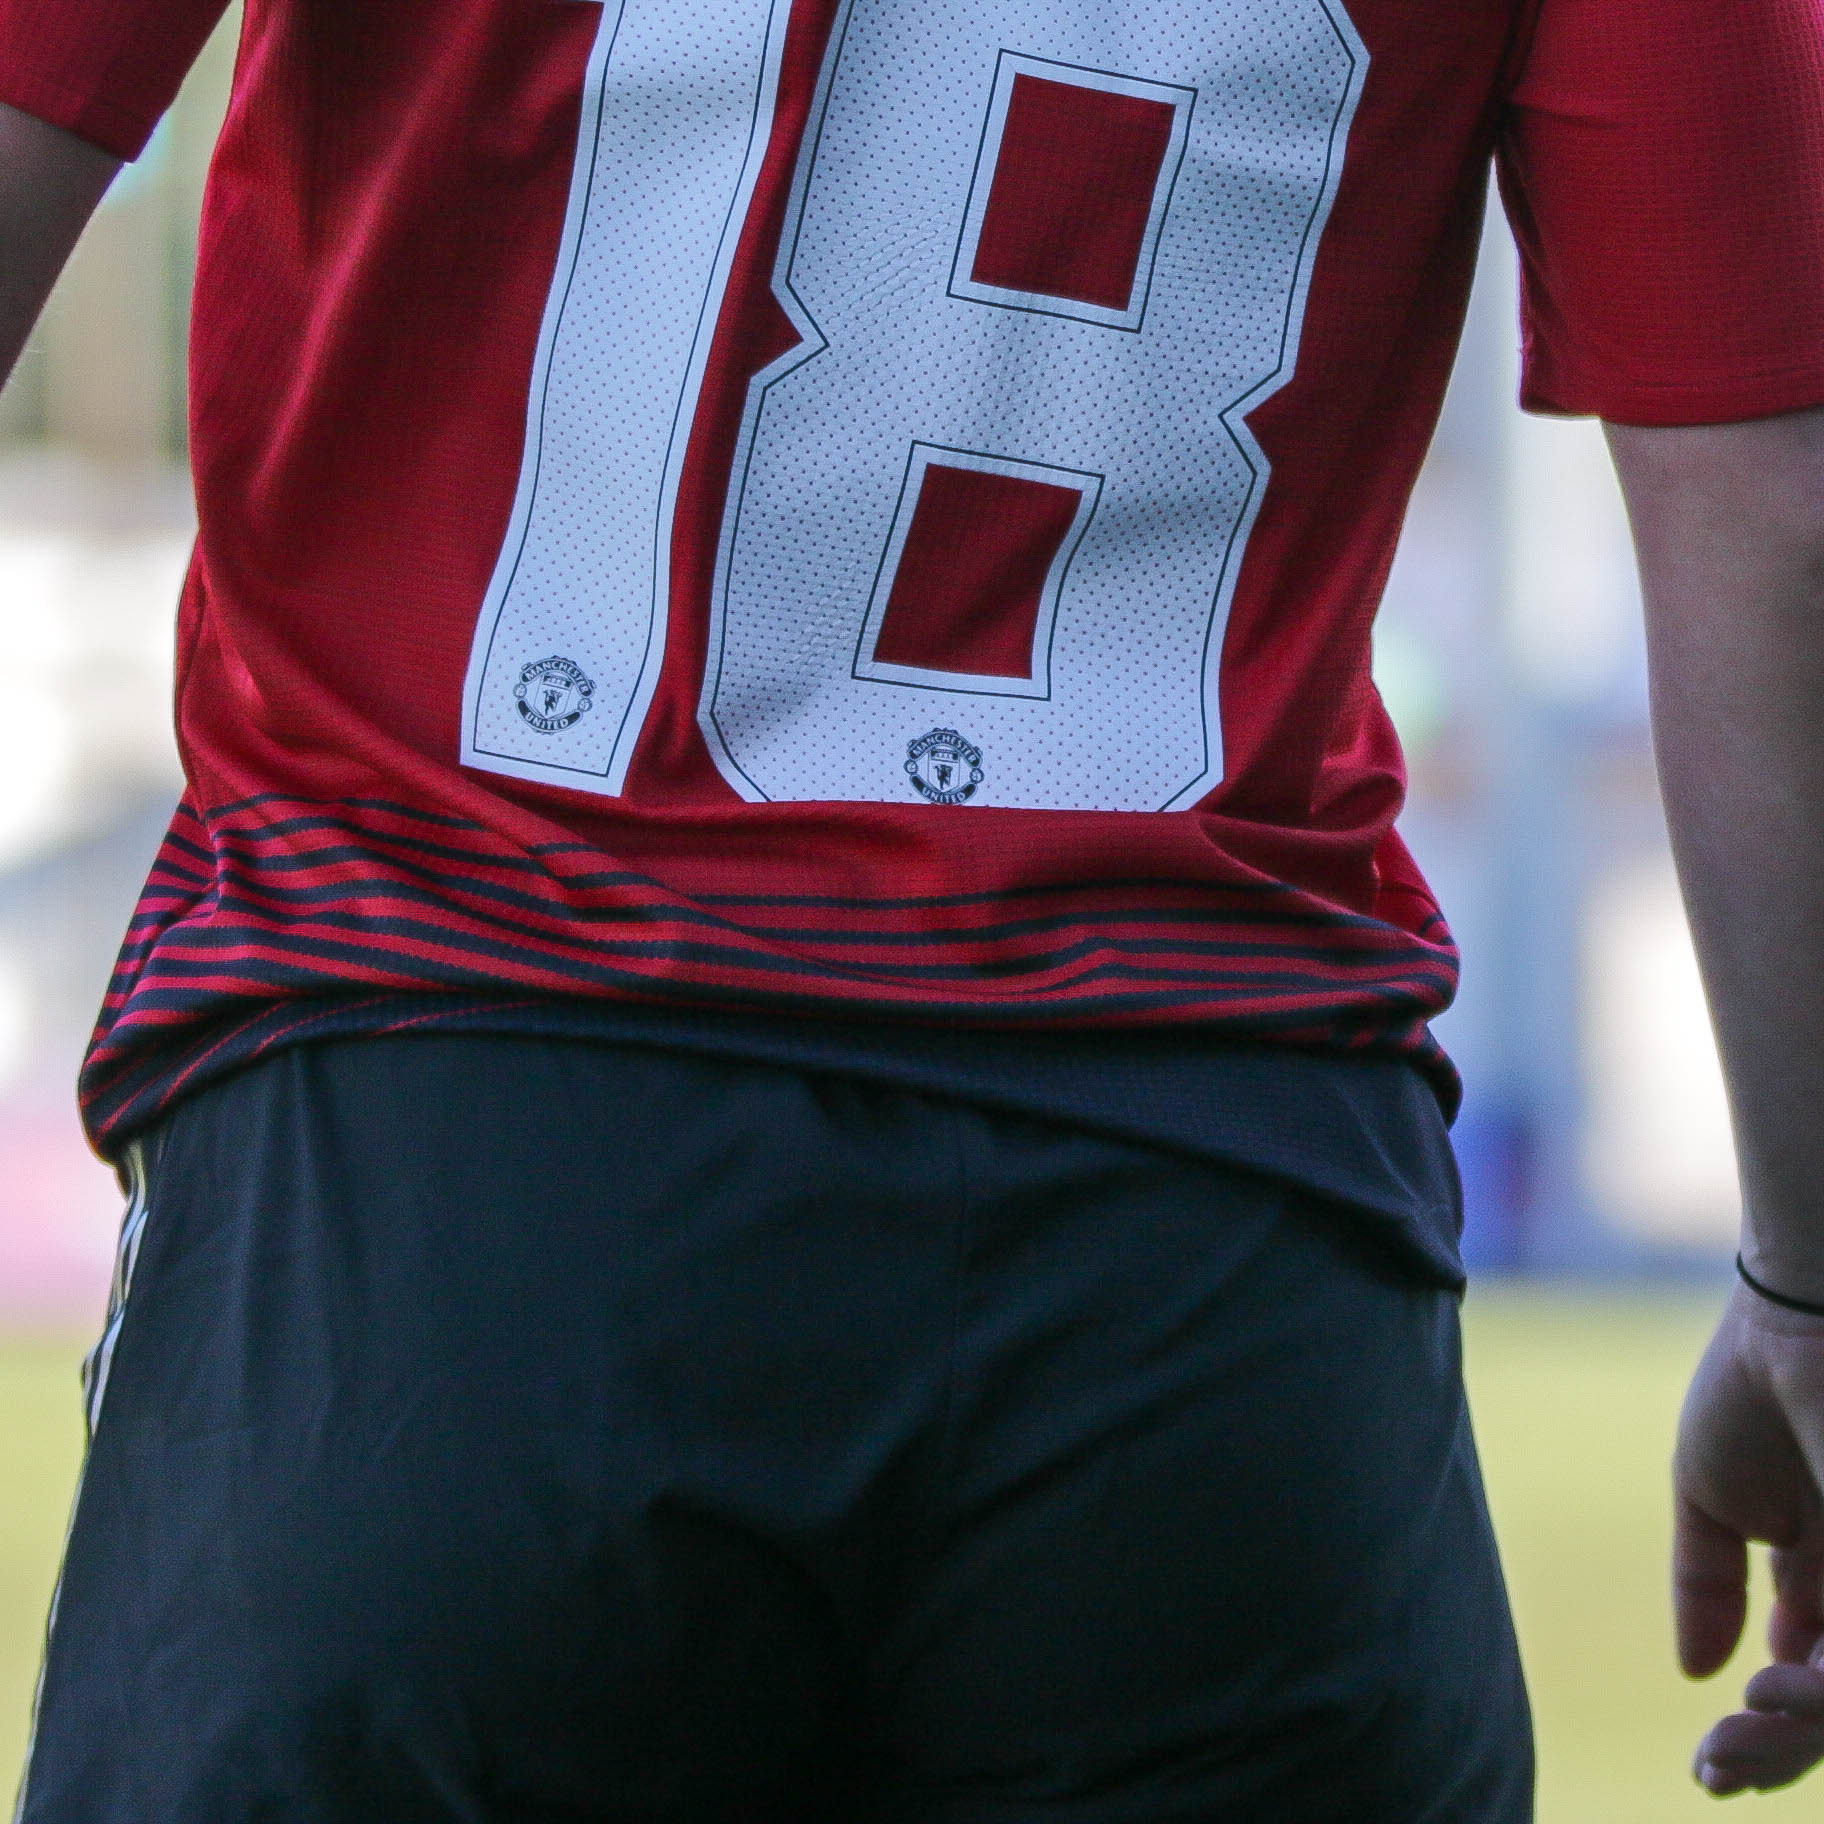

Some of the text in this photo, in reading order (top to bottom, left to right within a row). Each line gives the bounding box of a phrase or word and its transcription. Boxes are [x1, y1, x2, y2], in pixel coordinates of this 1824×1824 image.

[523, 660, 592, 694] MANCHESTER
[524, 711, 570, 730] UNITED
[912, 733, 977, 764] MANCHESTER
[921, 786, 967, 804] UNITED
